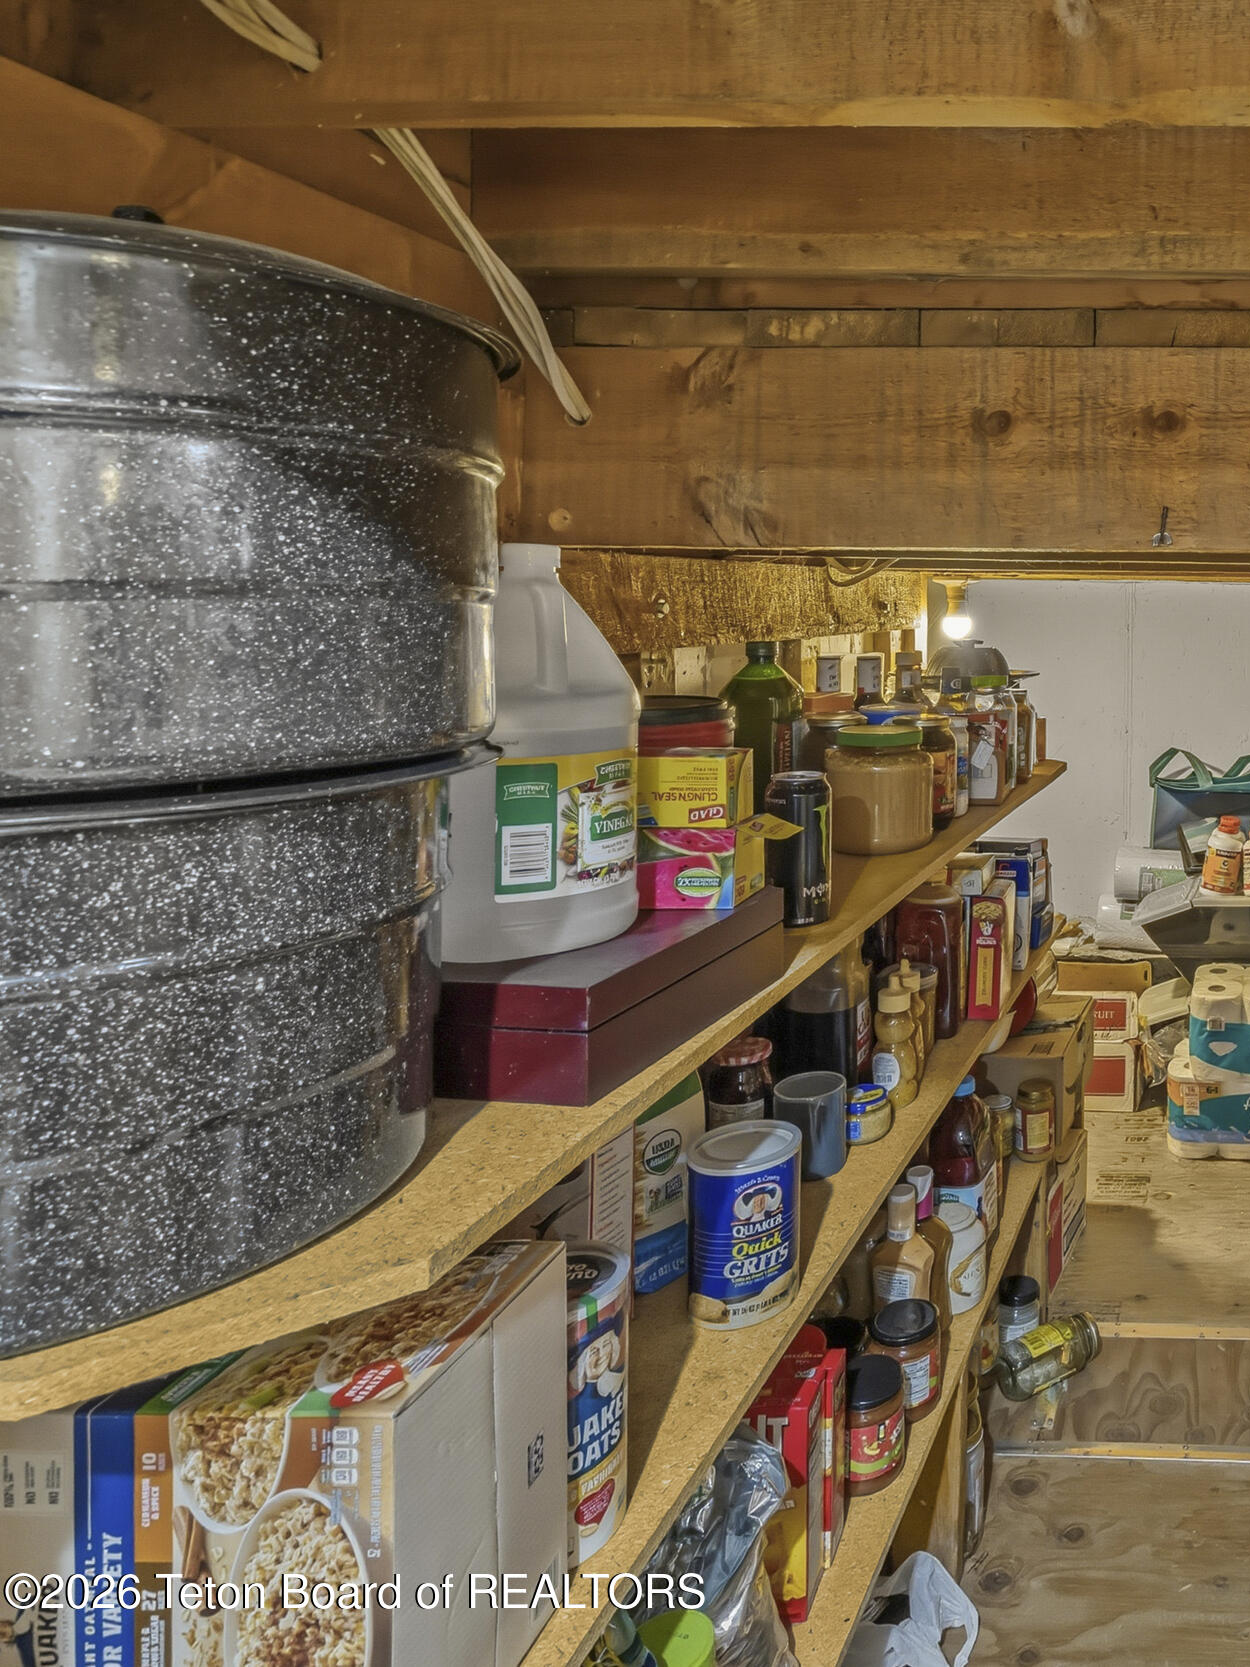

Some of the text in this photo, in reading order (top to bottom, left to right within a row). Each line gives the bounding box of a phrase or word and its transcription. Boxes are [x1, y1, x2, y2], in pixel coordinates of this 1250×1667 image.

[651, 791, 676, 802] SEAL
[594, 815, 633, 834] VINEGA
[689, 806, 724, 821] GLAD
[732, 1213, 783, 1238] QUAKER
[731, 1232, 783, 1259] Quick
[722, 1241, 790, 1280] GRITS
[568, 1392, 625, 1451] UAKE
[567, 1418, 623, 1477] OATS
[141, 1452, 157, 1471] 10
[83, 1556, 97, 1636] OATAL
[102, 1532, 123, 1638] VARETY
[141, 1588, 157, 1611] 27
